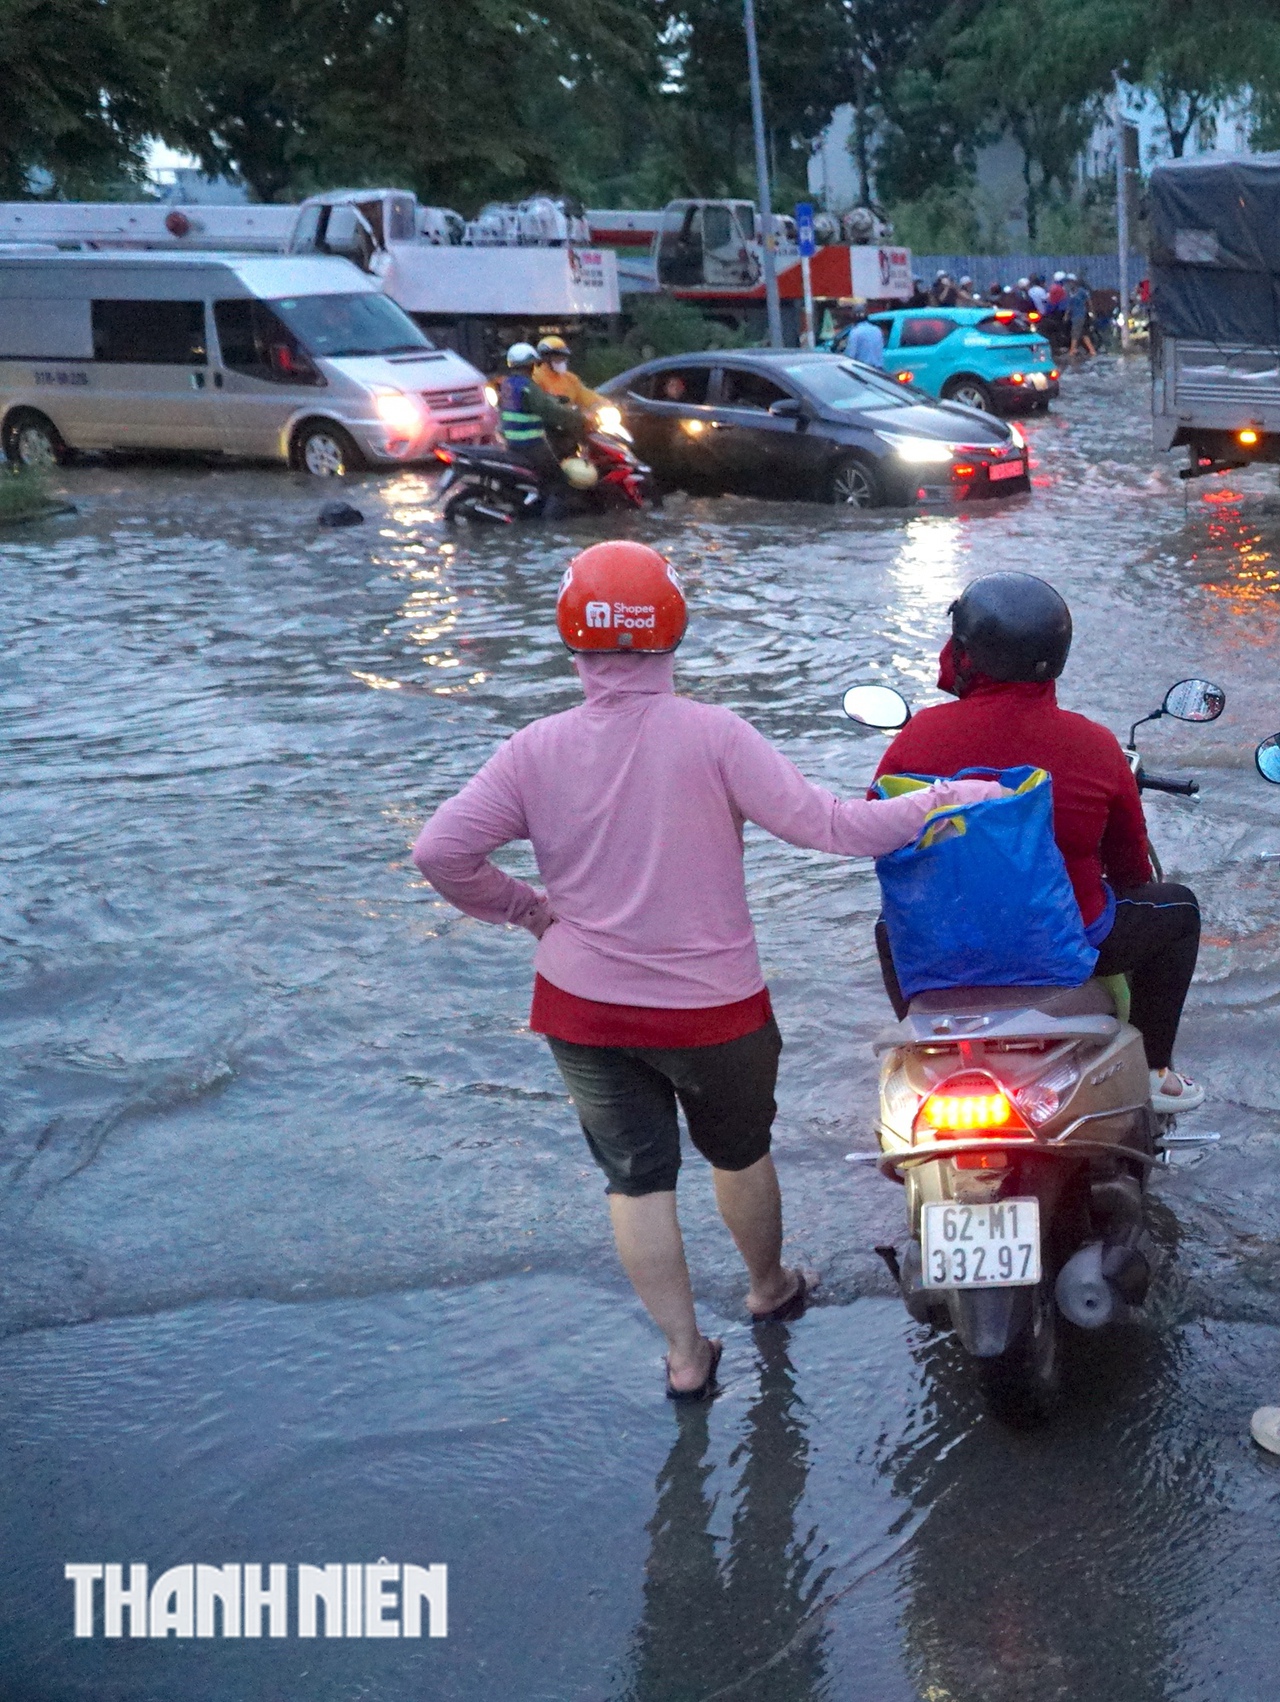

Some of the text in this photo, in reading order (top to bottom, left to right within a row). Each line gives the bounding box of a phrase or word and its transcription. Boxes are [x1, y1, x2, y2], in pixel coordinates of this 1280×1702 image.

[613, 602, 655, 615] Shopee
[613, 614, 655, 628] Food
[932, 1244, 1032, 1283] 332.97
